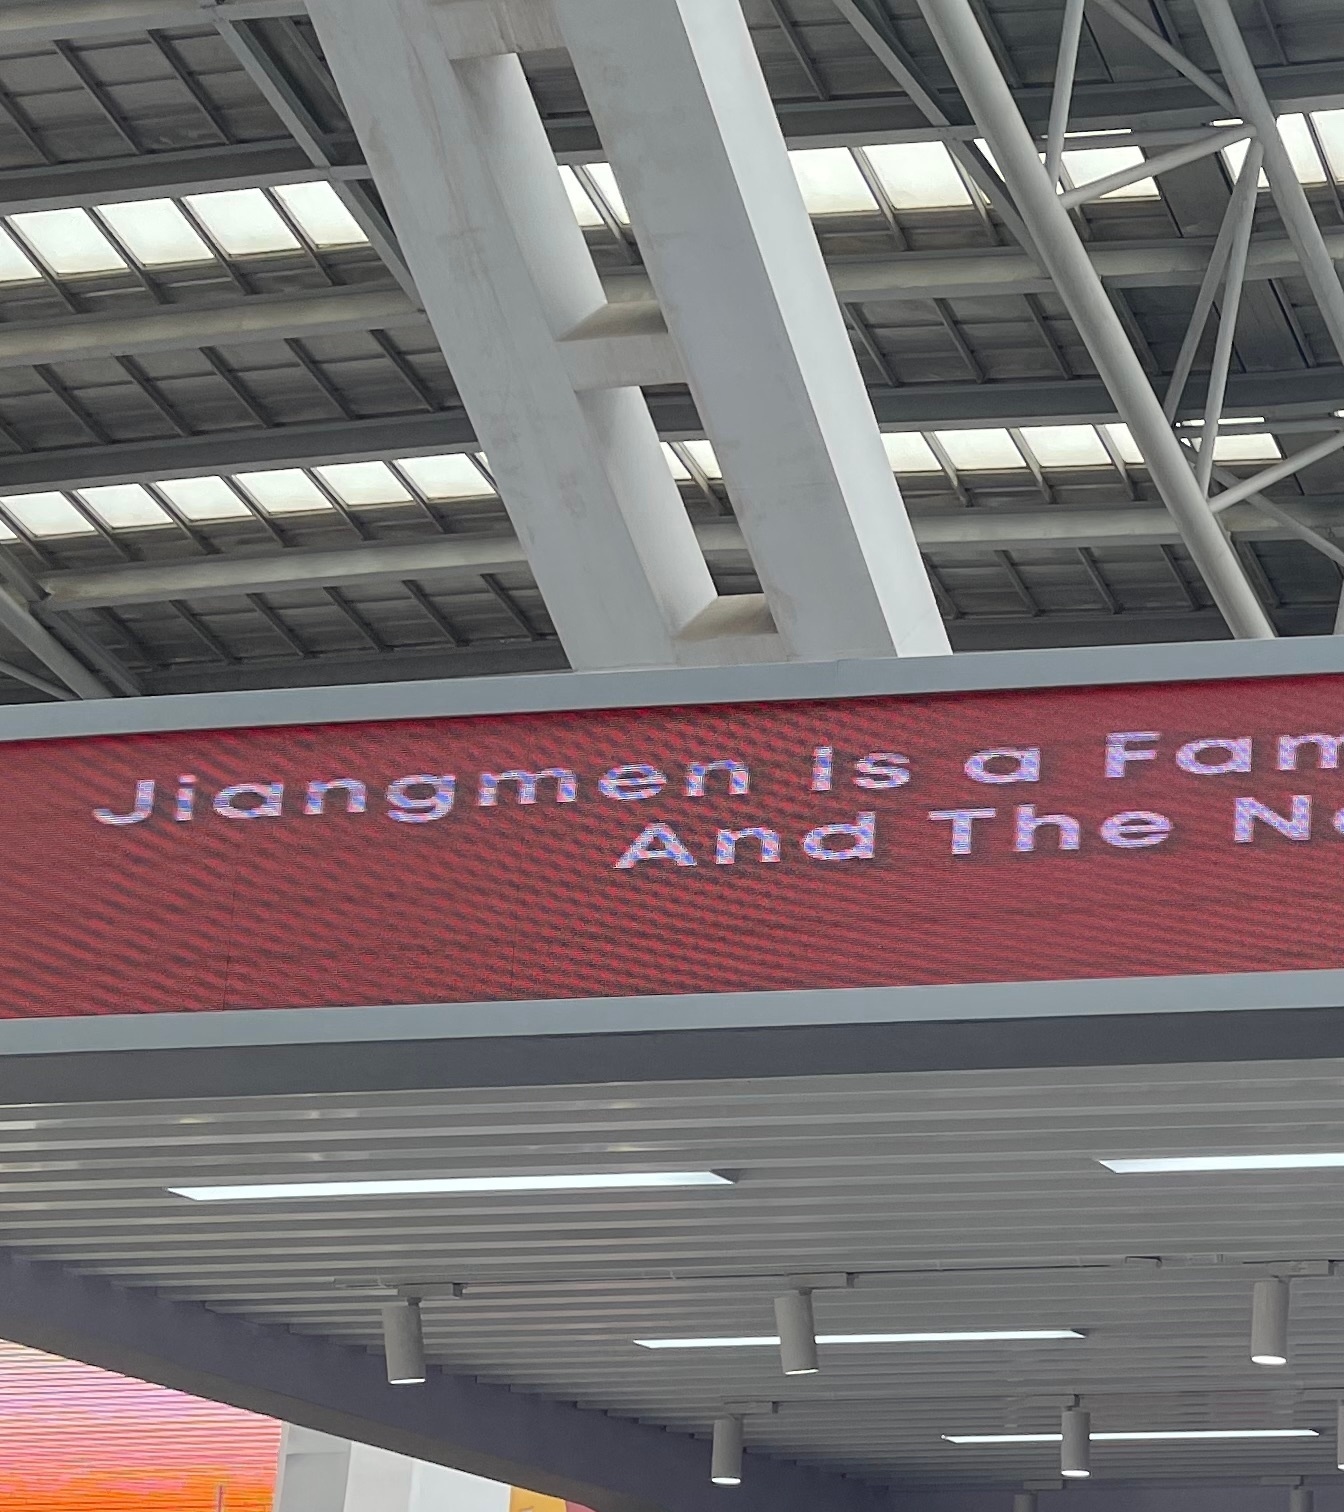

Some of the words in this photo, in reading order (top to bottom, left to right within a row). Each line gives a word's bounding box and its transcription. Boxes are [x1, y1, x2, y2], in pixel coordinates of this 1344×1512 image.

[93, 760, 752, 826] Jiangmen
[812, 746, 911, 791] Is
[964, 747, 1042, 786] a
[614, 811, 876, 869] And
[928, 804, 1171, 855] The
